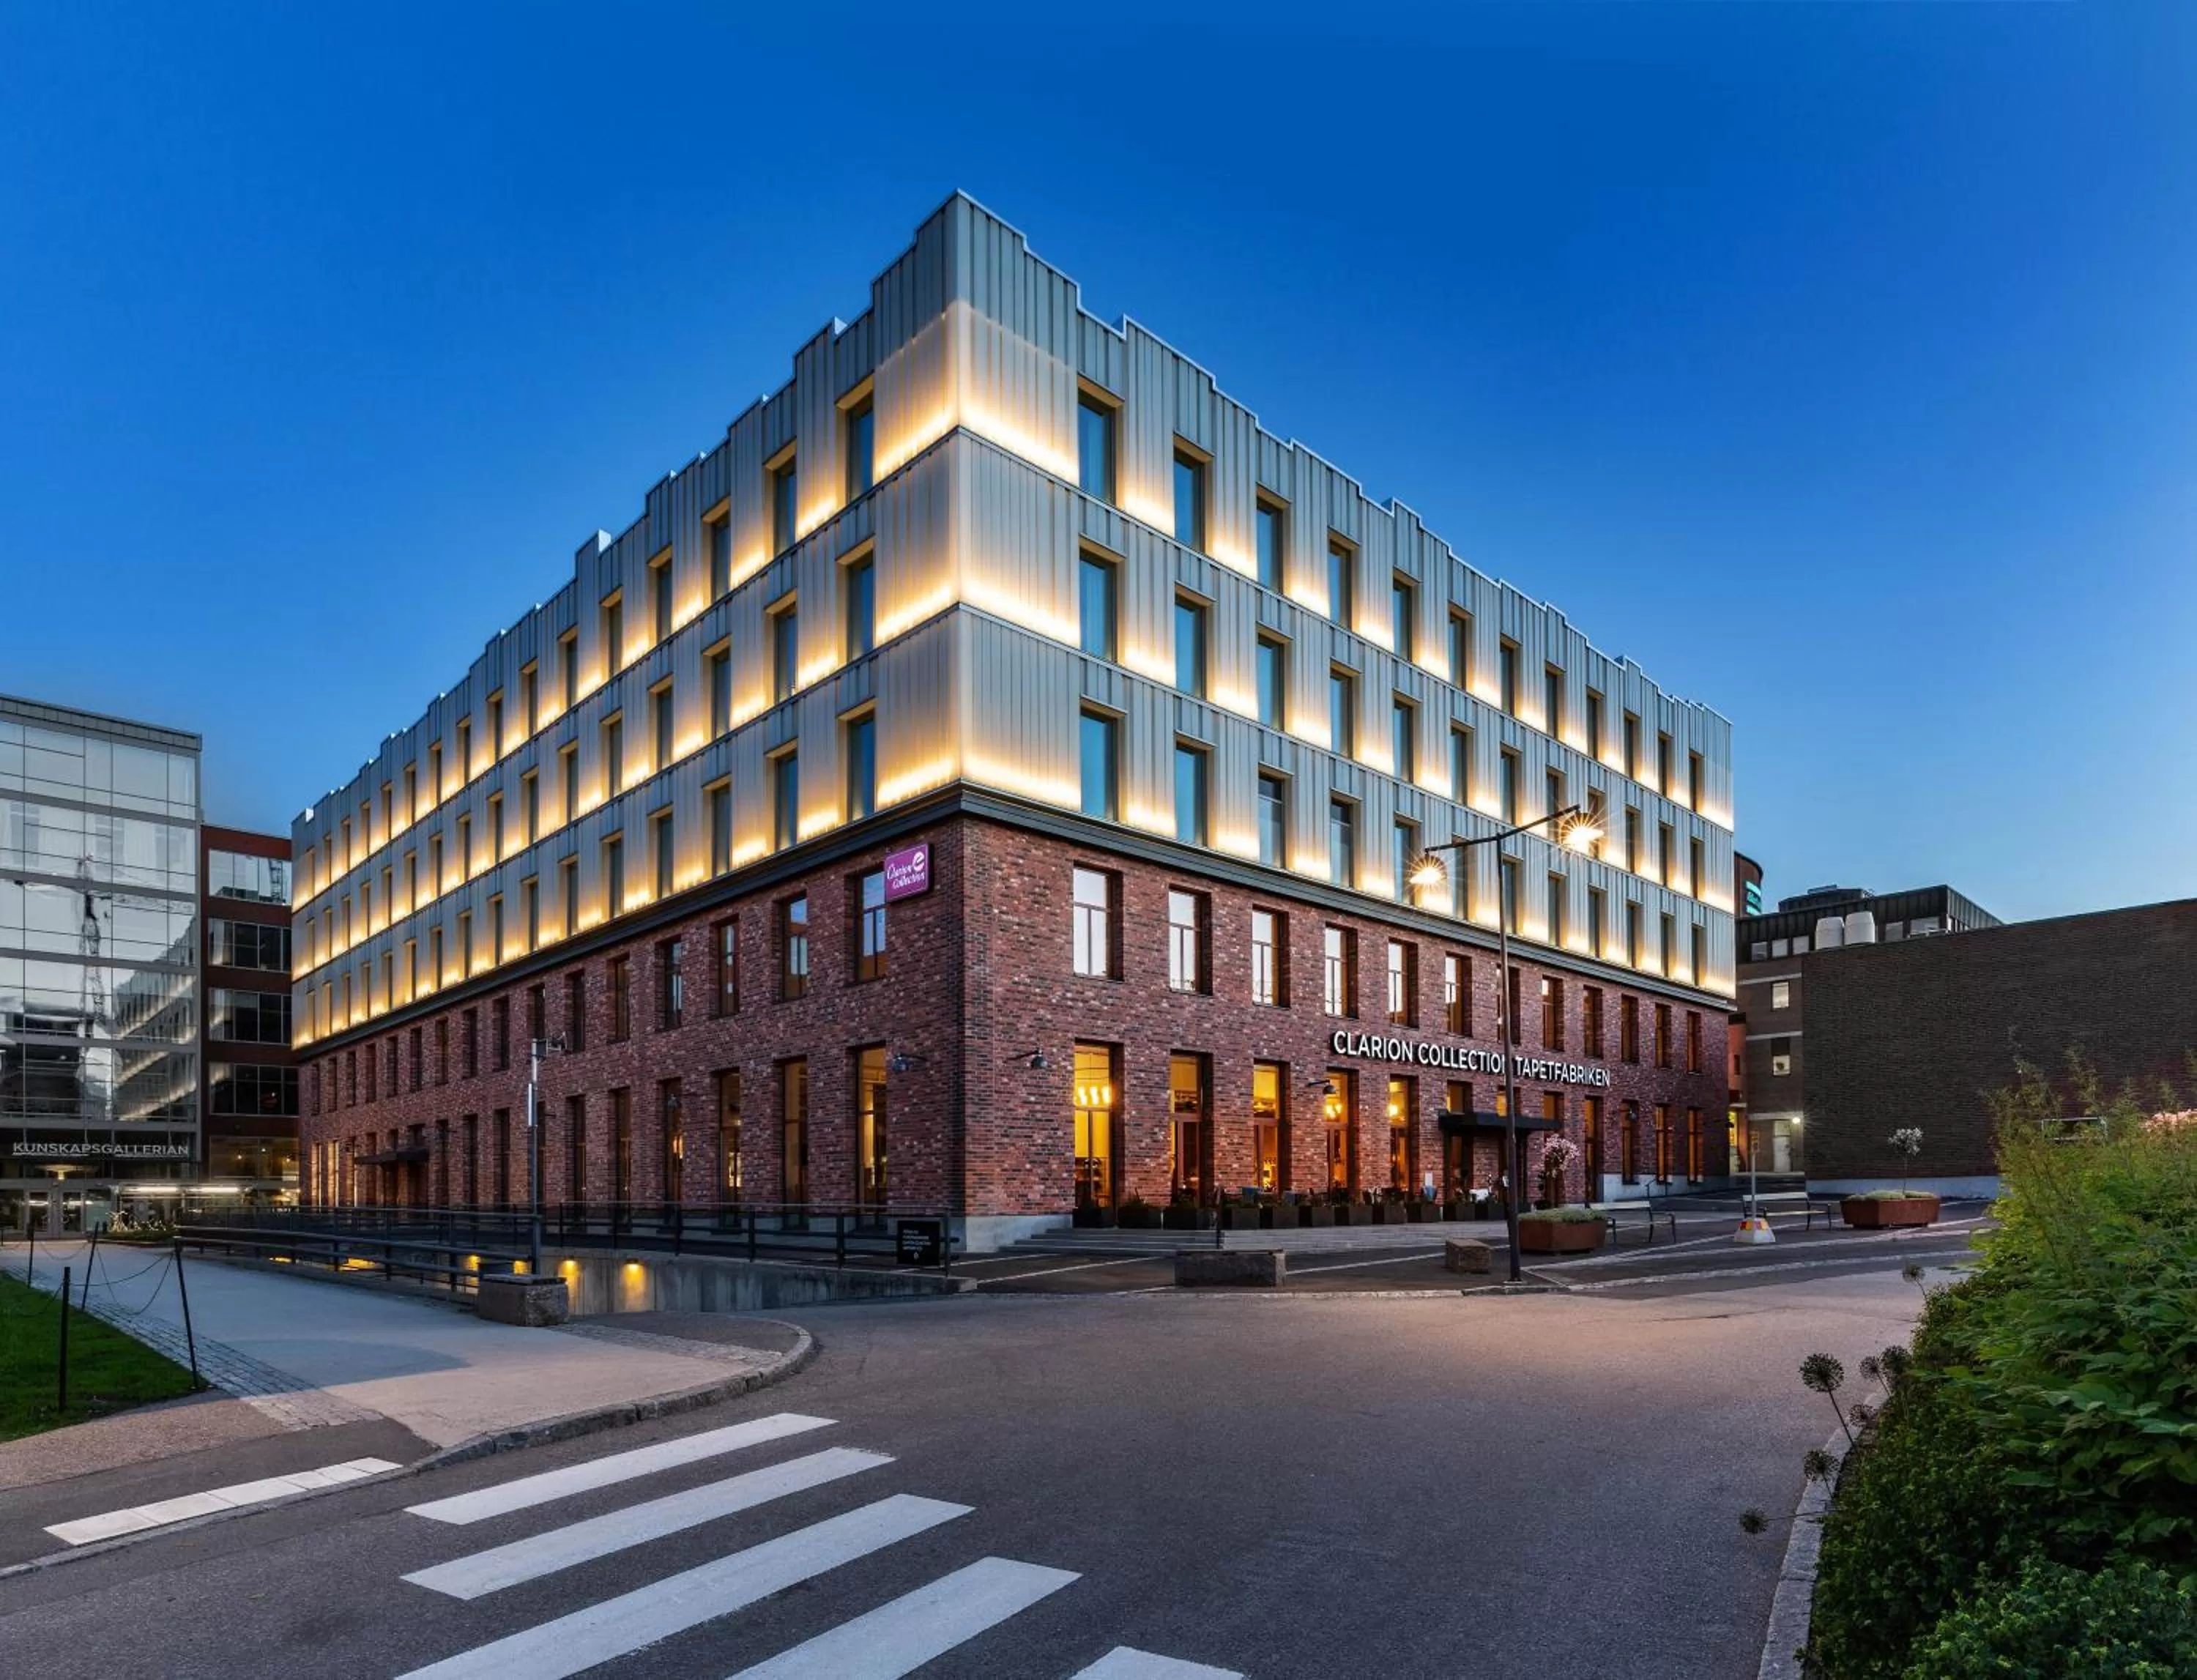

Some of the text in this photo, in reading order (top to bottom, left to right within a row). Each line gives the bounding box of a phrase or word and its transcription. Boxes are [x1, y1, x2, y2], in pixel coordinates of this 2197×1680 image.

[1334, 1030, 1413, 1063] CLARION
[1515, 1055, 1611, 1088] TAPETFABRIKEN
[12, 1142, 189, 1156] KUNSKAPSGALLERIAN
